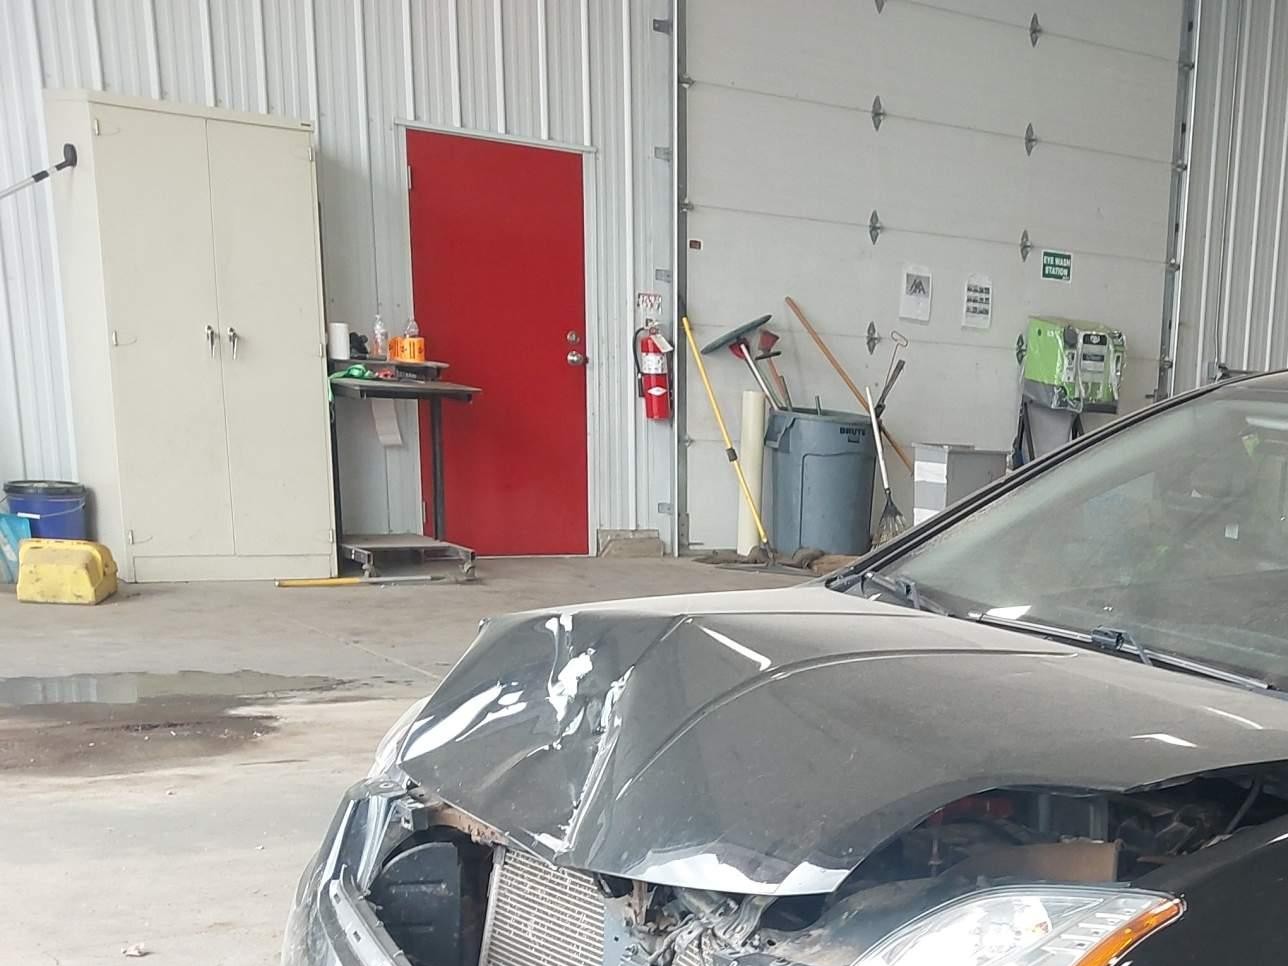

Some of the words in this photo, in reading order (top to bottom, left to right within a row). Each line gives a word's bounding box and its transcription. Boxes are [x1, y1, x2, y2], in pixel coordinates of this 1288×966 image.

[1043, 255, 1055, 265] EYE
[1055, 257, 1071, 267] WASH
[1045, 266, 1069, 276] STATION
